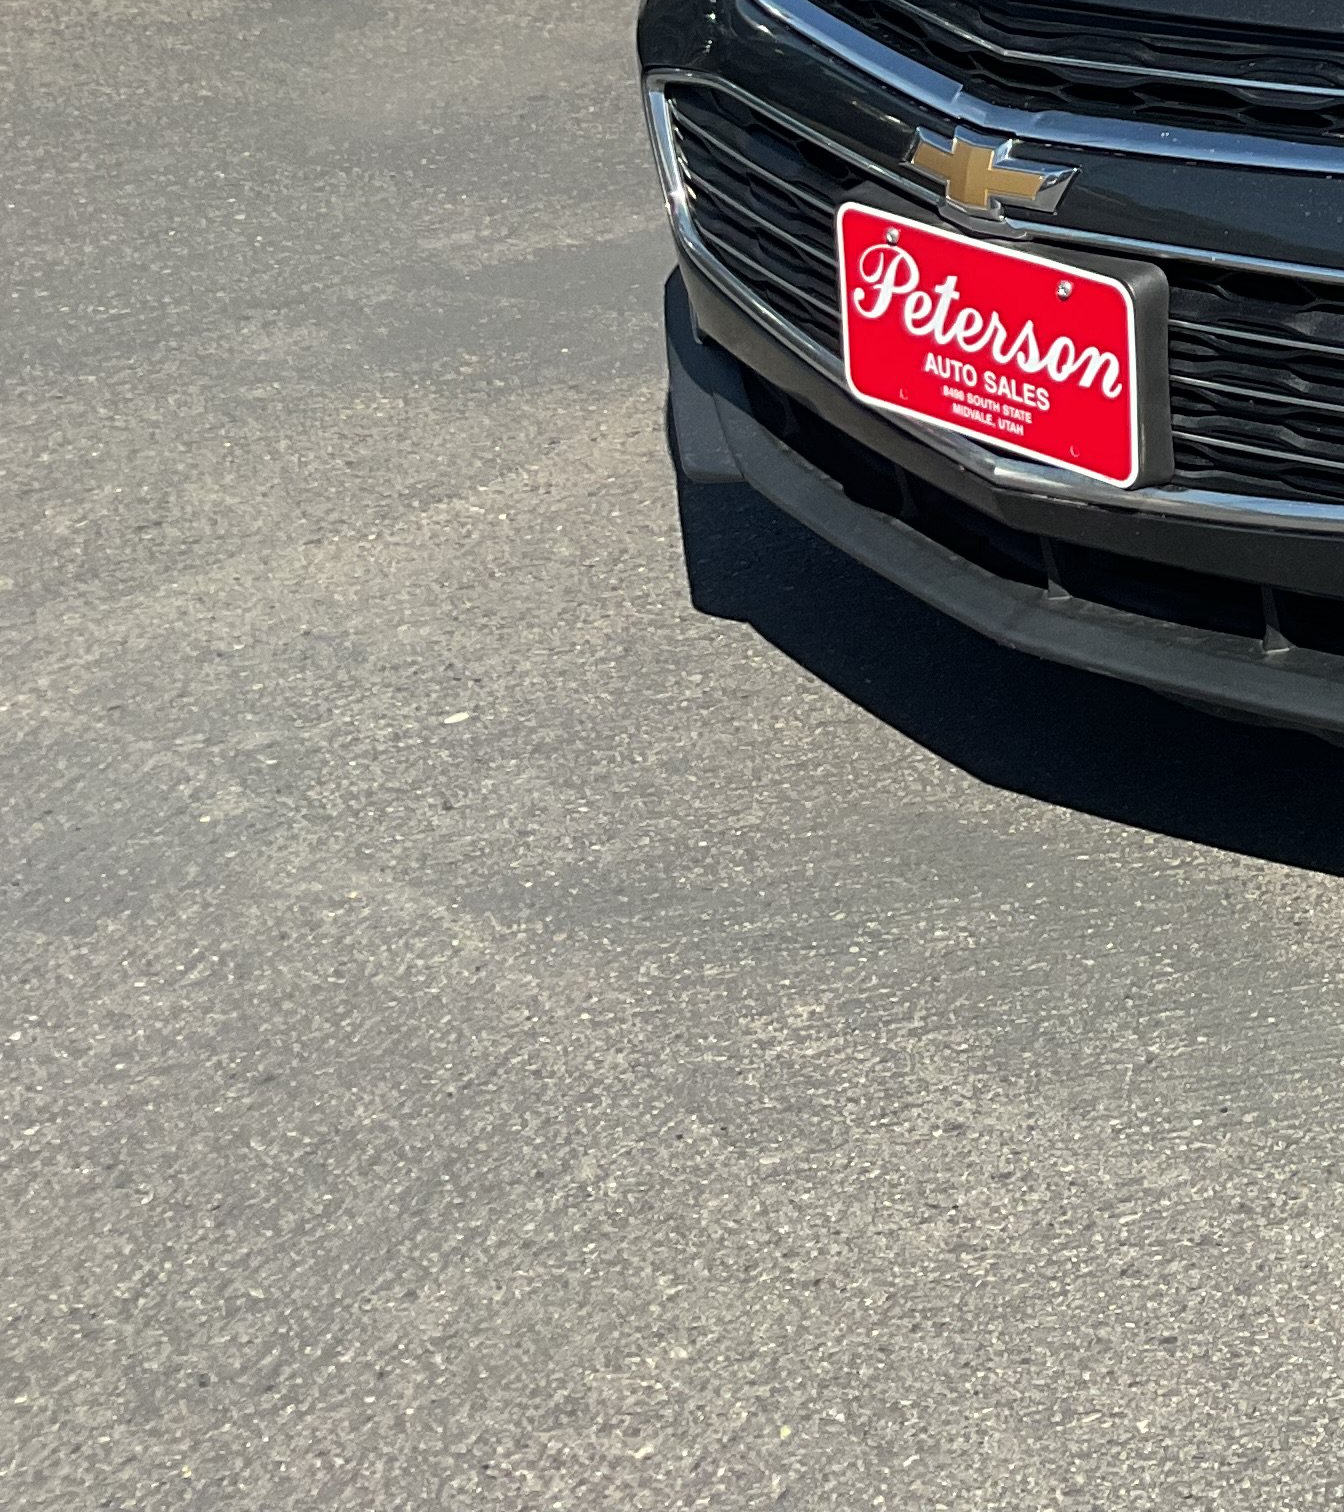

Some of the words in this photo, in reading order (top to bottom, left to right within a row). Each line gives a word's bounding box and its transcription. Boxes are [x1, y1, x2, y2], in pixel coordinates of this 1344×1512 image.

[853, 243, 1123, 400] Peterson
[924, 351, 978, 387] AUTO
[983, 370, 1051, 412] SALES
[966, 392, 1001, 413] SOUTH
[1002, 404, 1033, 424] STATE
[997, 417, 1025, 437] UTAH
